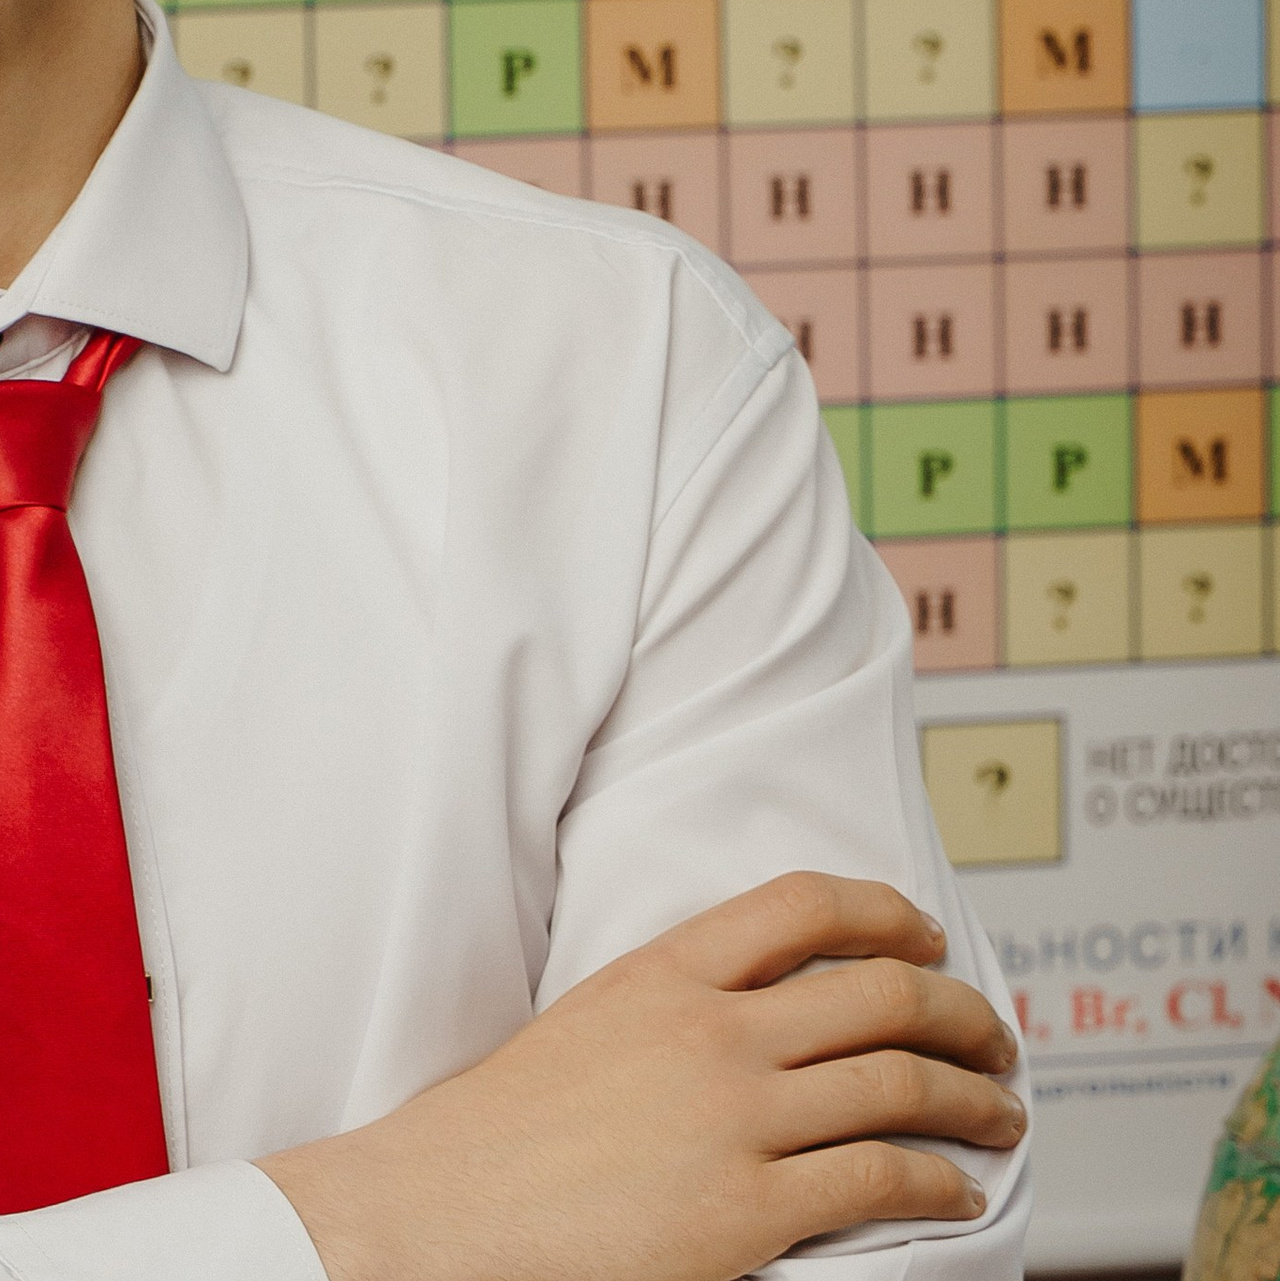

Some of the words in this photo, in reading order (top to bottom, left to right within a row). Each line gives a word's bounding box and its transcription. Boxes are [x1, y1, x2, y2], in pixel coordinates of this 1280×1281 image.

[501, 51, 536, 97] Р
[623, 43, 678, 92] М
[1039, 28, 1092, 76] М
[769, 174, 811, 221] Н
[910, 169, 952, 215] Н
[1046, 163, 1087, 210] Н
[912, 314, 954, 360] Н
[1047, 307, 1089, 354] Н
[1180, 301, 1222, 348] Н
[1052, 446, 1088, 492] Р
[1176, 437, 1229, 484] М
[915, 590, 956, 636] Н
